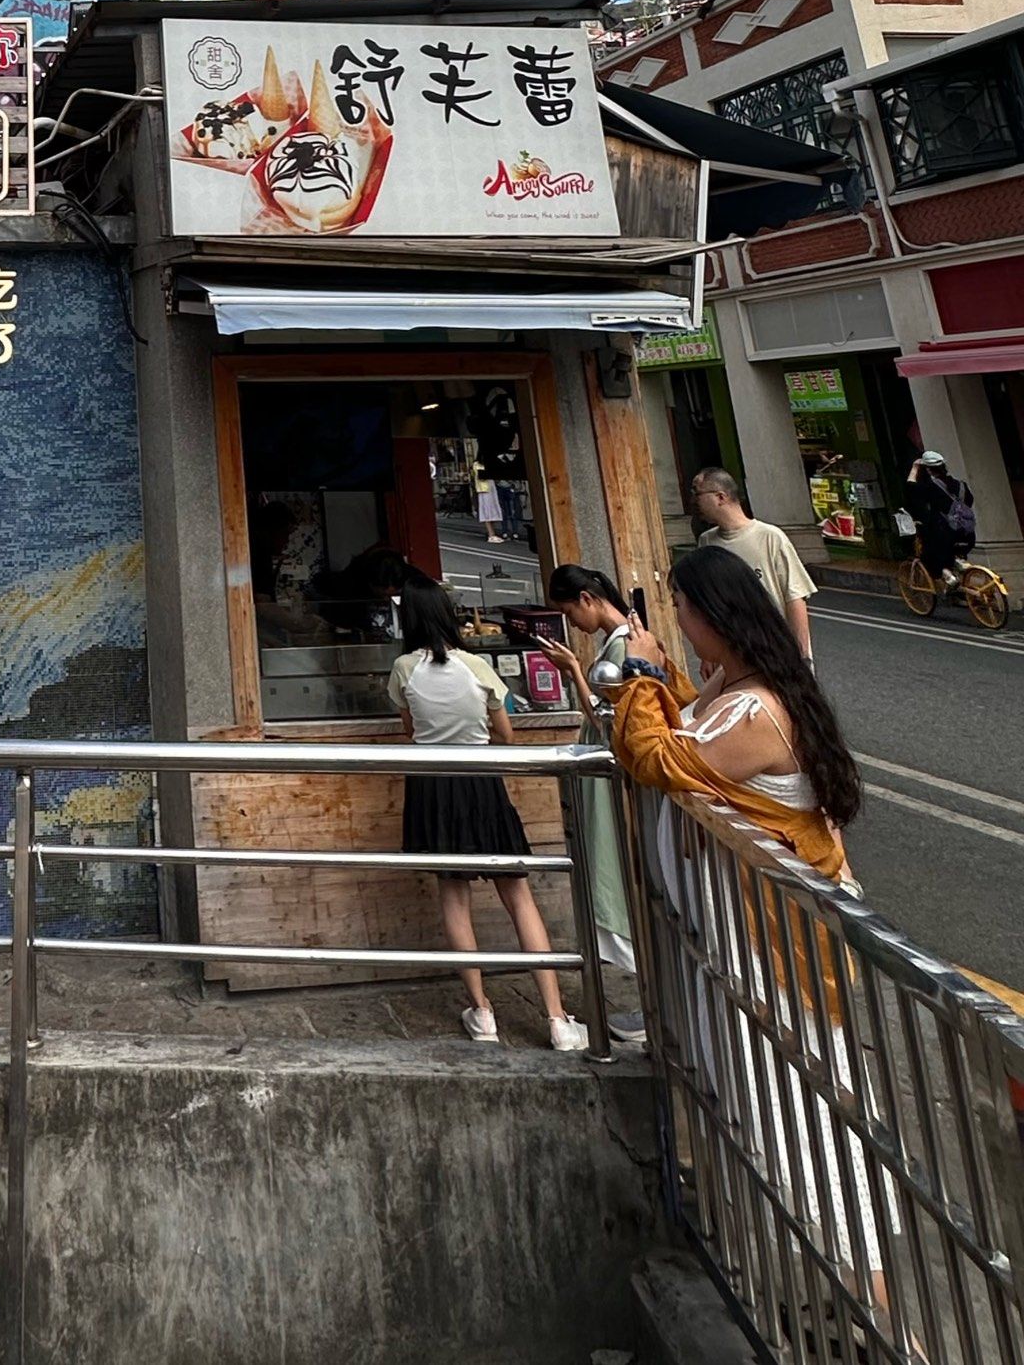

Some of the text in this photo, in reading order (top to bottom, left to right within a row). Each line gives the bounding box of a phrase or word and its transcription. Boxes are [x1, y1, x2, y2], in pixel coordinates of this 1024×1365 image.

[207, 46, 223, 80] 甜舍
[329, 38, 577, 127] 舒芙蕾
[483, 159, 540, 201] Amoy
